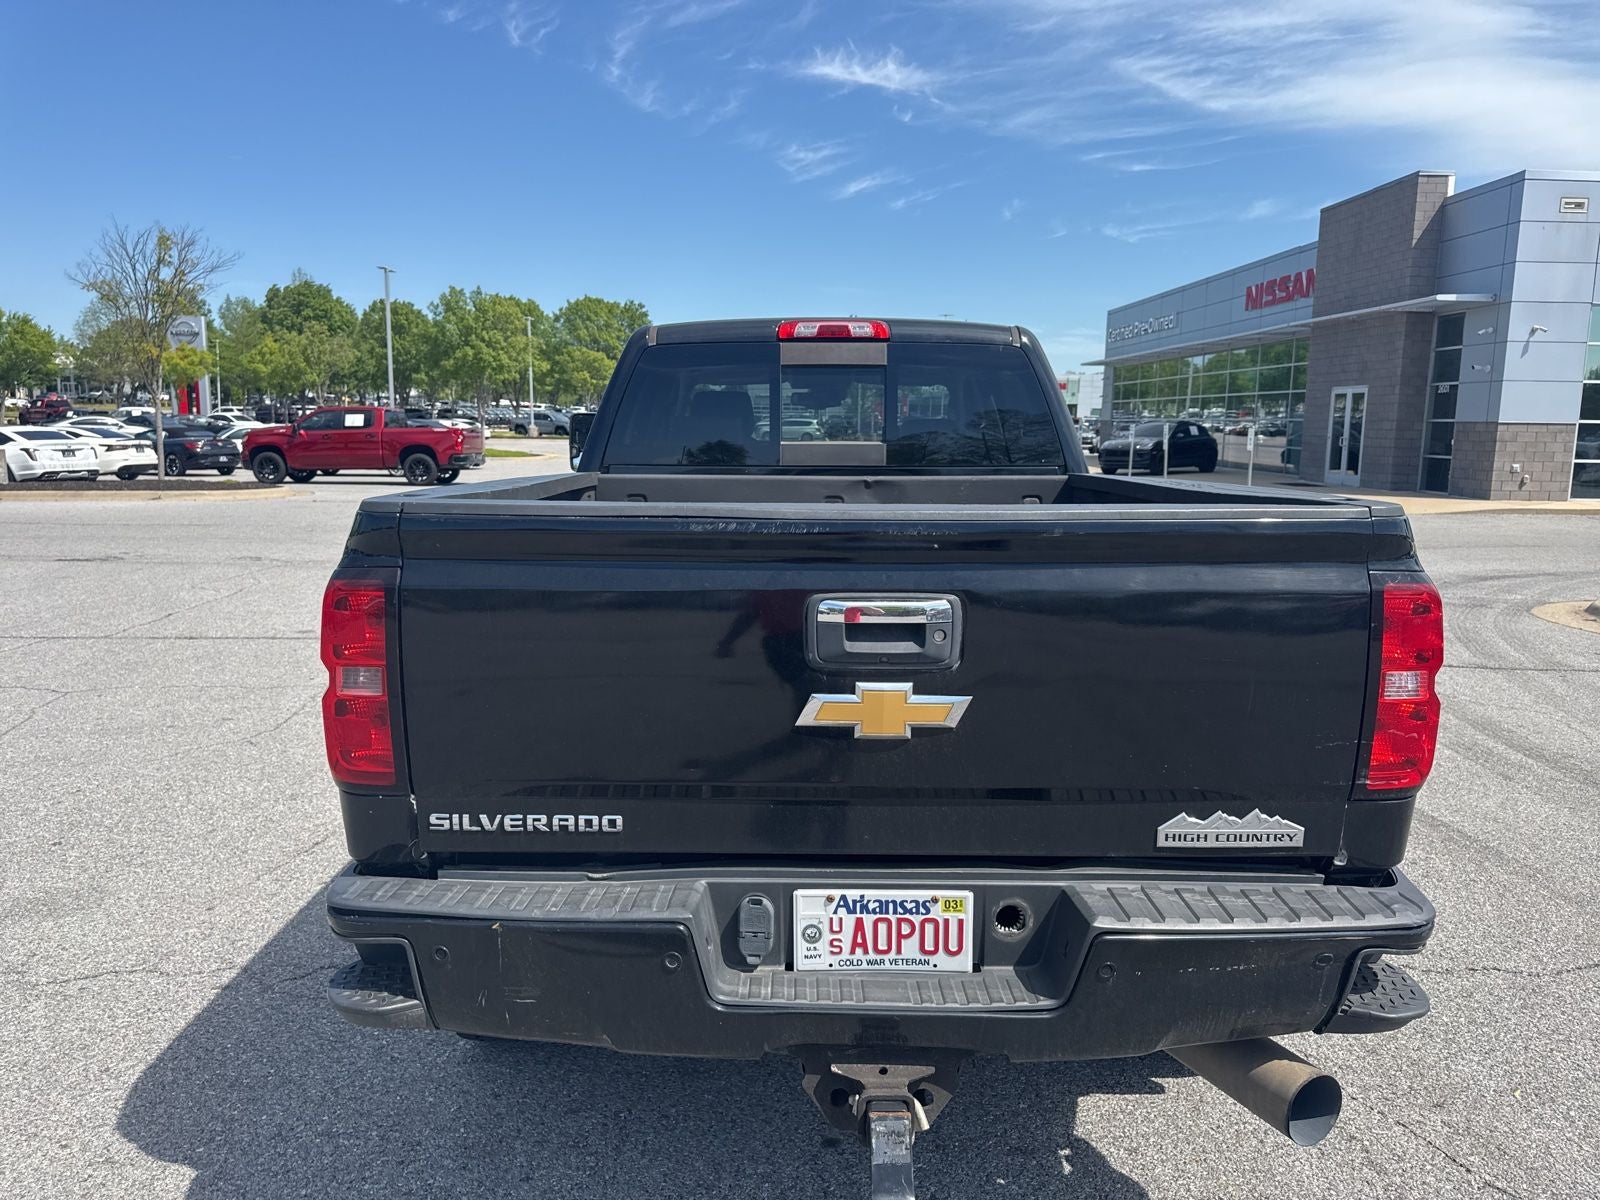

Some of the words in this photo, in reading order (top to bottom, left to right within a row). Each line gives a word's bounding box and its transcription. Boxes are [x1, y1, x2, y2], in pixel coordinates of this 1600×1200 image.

[1245, 268, 1316, 311] NISSAN
[429, 813, 623, 832] SILVERADO
[1164, 833, 1208, 842] HIGH
[1215, 833, 1298, 843] COUNTRY
[833, 894, 931, 916] Arkansas
[944, 899, 958, 910] 03
[838, 959, 863, 967] COLD
[866, 958, 886, 967] WAR
[888, 958, 930, 966] VETERAN
